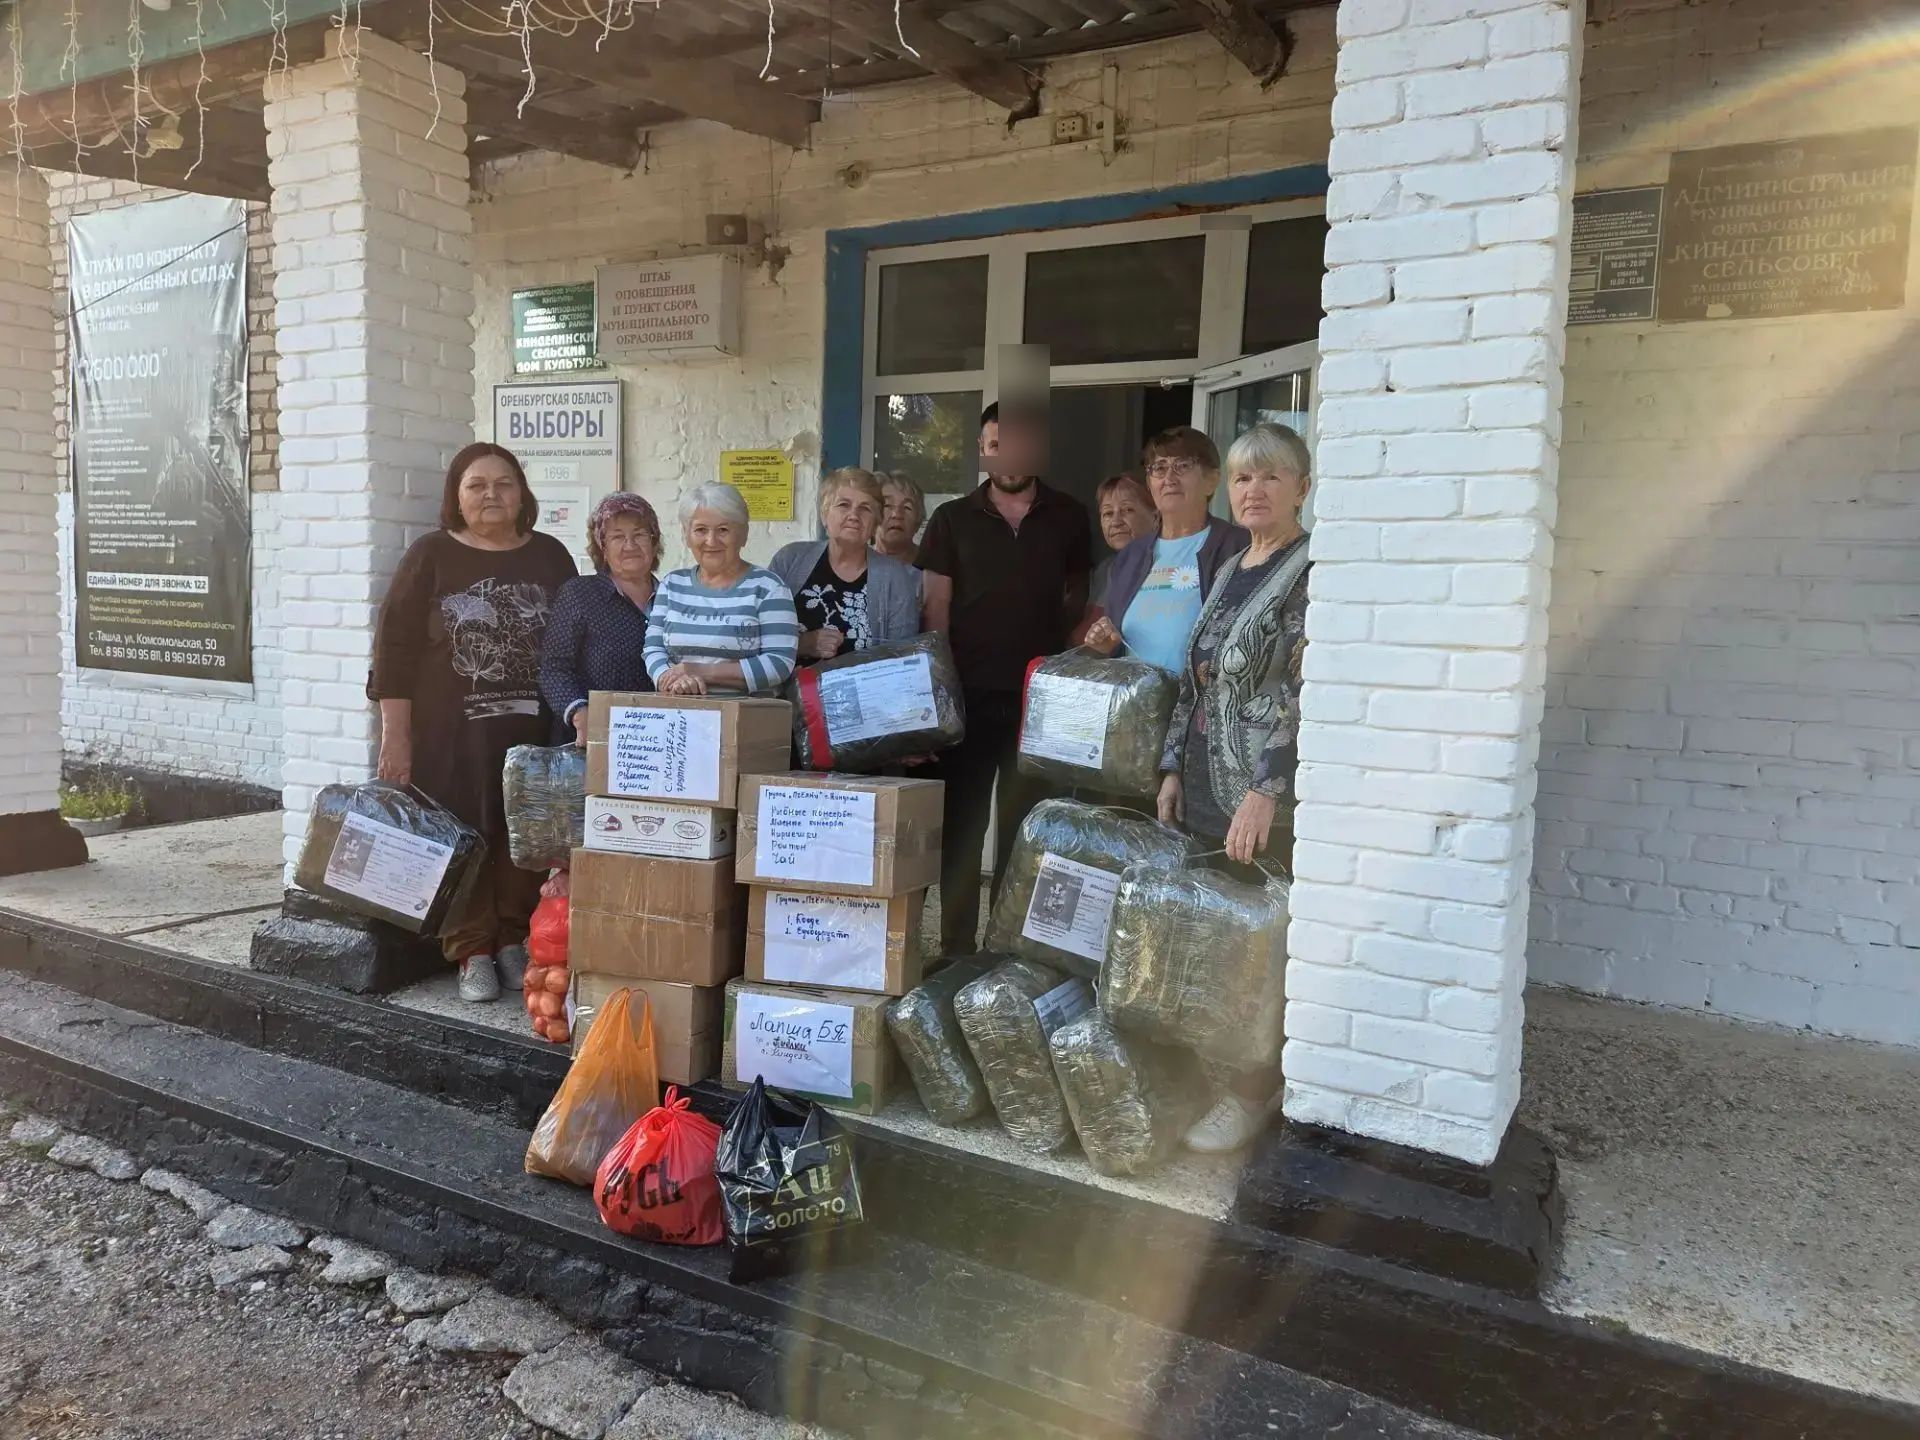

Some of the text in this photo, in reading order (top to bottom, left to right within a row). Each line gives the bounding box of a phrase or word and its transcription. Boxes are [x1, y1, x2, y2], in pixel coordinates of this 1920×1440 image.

[1674, 165, 1914, 207] АДМИНИСТРАЦИЯ
[1674, 224, 1898, 260] КИНДЕЛИНСКИЙ
[127, 252, 144, 271] ПО
[147, 240, 220, 269] КОНТРАКТУ
[1703, 251, 1865, 279] СЕЛЬСОВЕТ
[191, 262, 235, 285] СИЛАХ
[640, 271, 671, 283] ШТАБ
[612, 299, 698, 316] И ПУНКТ СБОРА
[516, 332, 594, 349] КИНДЕЛИНСКИ
[616, 330, 694, 345] ОБРАЗОВАНИЯ
[532, 344, 586, 360] СЕЛЬСКИЙ
[127, 353, 160, 379] 000
[516, 357, 603, 373] ДОМ КУЛЬТУРЫ
[501, 391, 614, 407] ОРЕНБУРГСКАЯ ОБЛАСТЬ
[510, 409, 604, 439] ВЫБОРЫ
[88, 575, 206, 590] ЕДИНЫЙ НОМЕР ДЛЯ ЗВОНКА: 122
[136, 633, 204, 650] Комсомольская,
[205, 638, 217, 650] 50
[89, 644, 104, 656] Тел.
[106, 646, 111, 657] 8
[112, 647, 125, 658] 961
[126, 648, 136, 659] 90
[138, 649, 149, 660] 95
[165, 651, 171, 662] 8
[172, 652, 185, 664] 961
[187, 653, 200, 665] 921
[201, 654, 212, 666] 67
[214, 655, 226, 667] 78
[502, 690, 518, 698] CAME
[518, 689, 528, 697] TO
[528, 689, 539, 697] ME
[618, 733, 659, 744] арахис
[617, 743, 664, 753] батончики
[617, 761, 660, 773] сгущенка
[618, 782, 650, 791] сушки
[765, 788, 786, 799] Группа
[772, 853, 795, 864] Чай
[776, 894, 800, 906] Группа
[750, 1012, 812, 1040] Лапша
[825, 1142, 841, 1158] 79
[771, 1163, 835, 1206] Au
[763, 1196, 846, 1231] ЗОЛОТО
